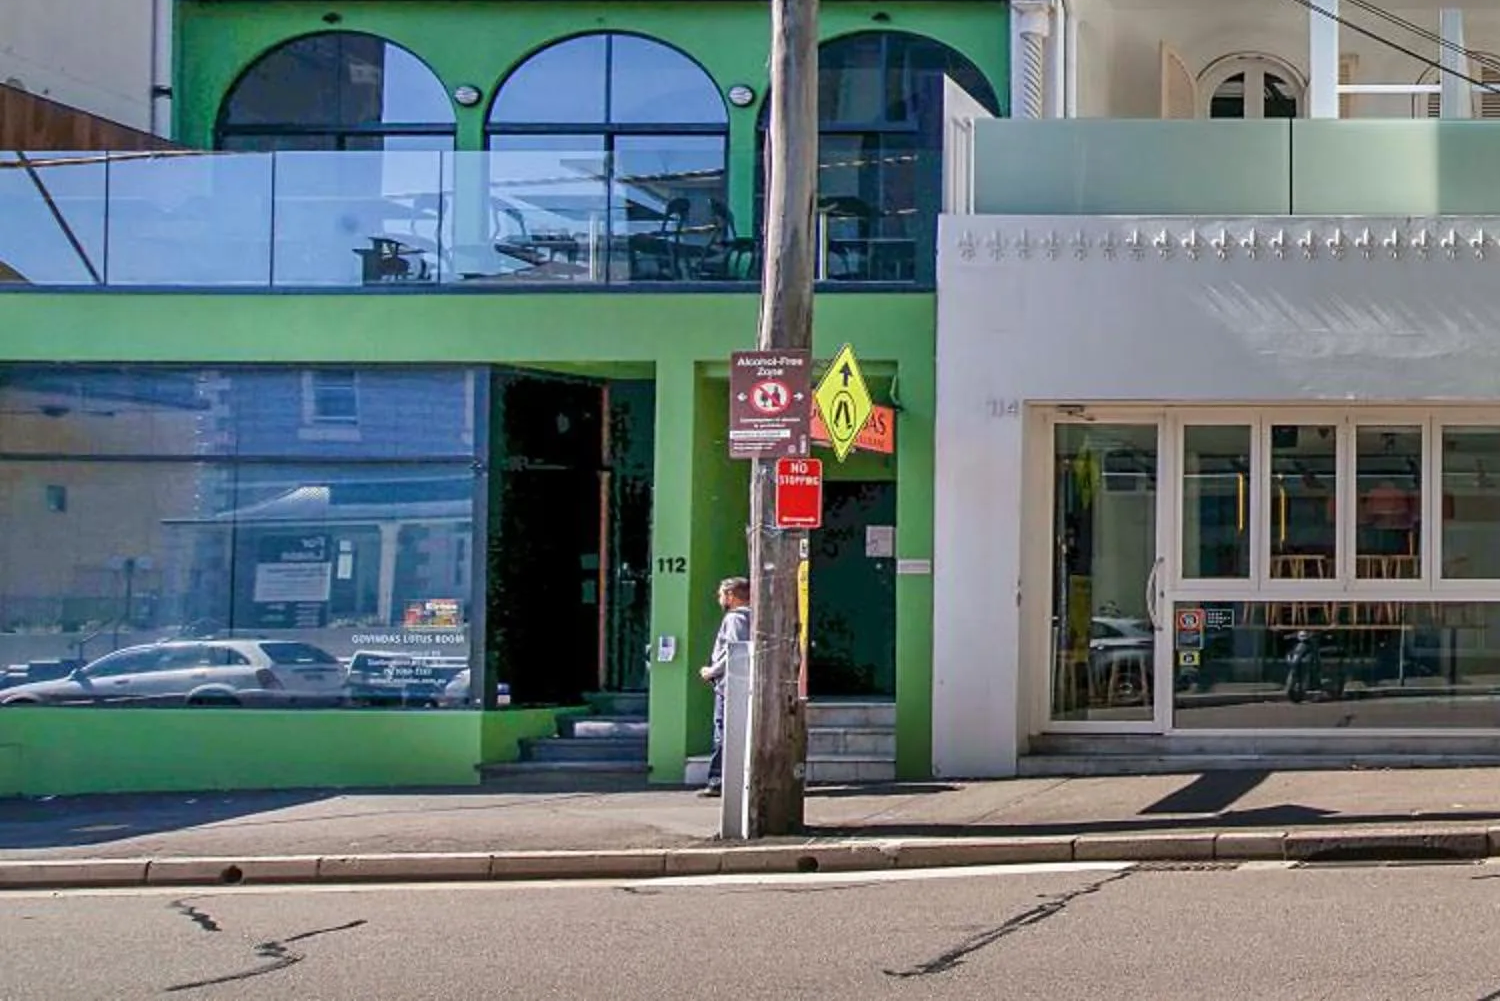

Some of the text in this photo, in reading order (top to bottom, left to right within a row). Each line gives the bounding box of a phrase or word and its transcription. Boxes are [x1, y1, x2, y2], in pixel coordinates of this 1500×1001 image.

[737, 357, 803, 367] Alcohol-Free
[757, 368, 783, 376] Zone
[790, 462, 809, 474] NO
[779, 475, 820, 486] STOPPING
[657, 556, 687, 574] 112
[351, 634, 466, 645] GOVINDAS LOTUS ROOM
